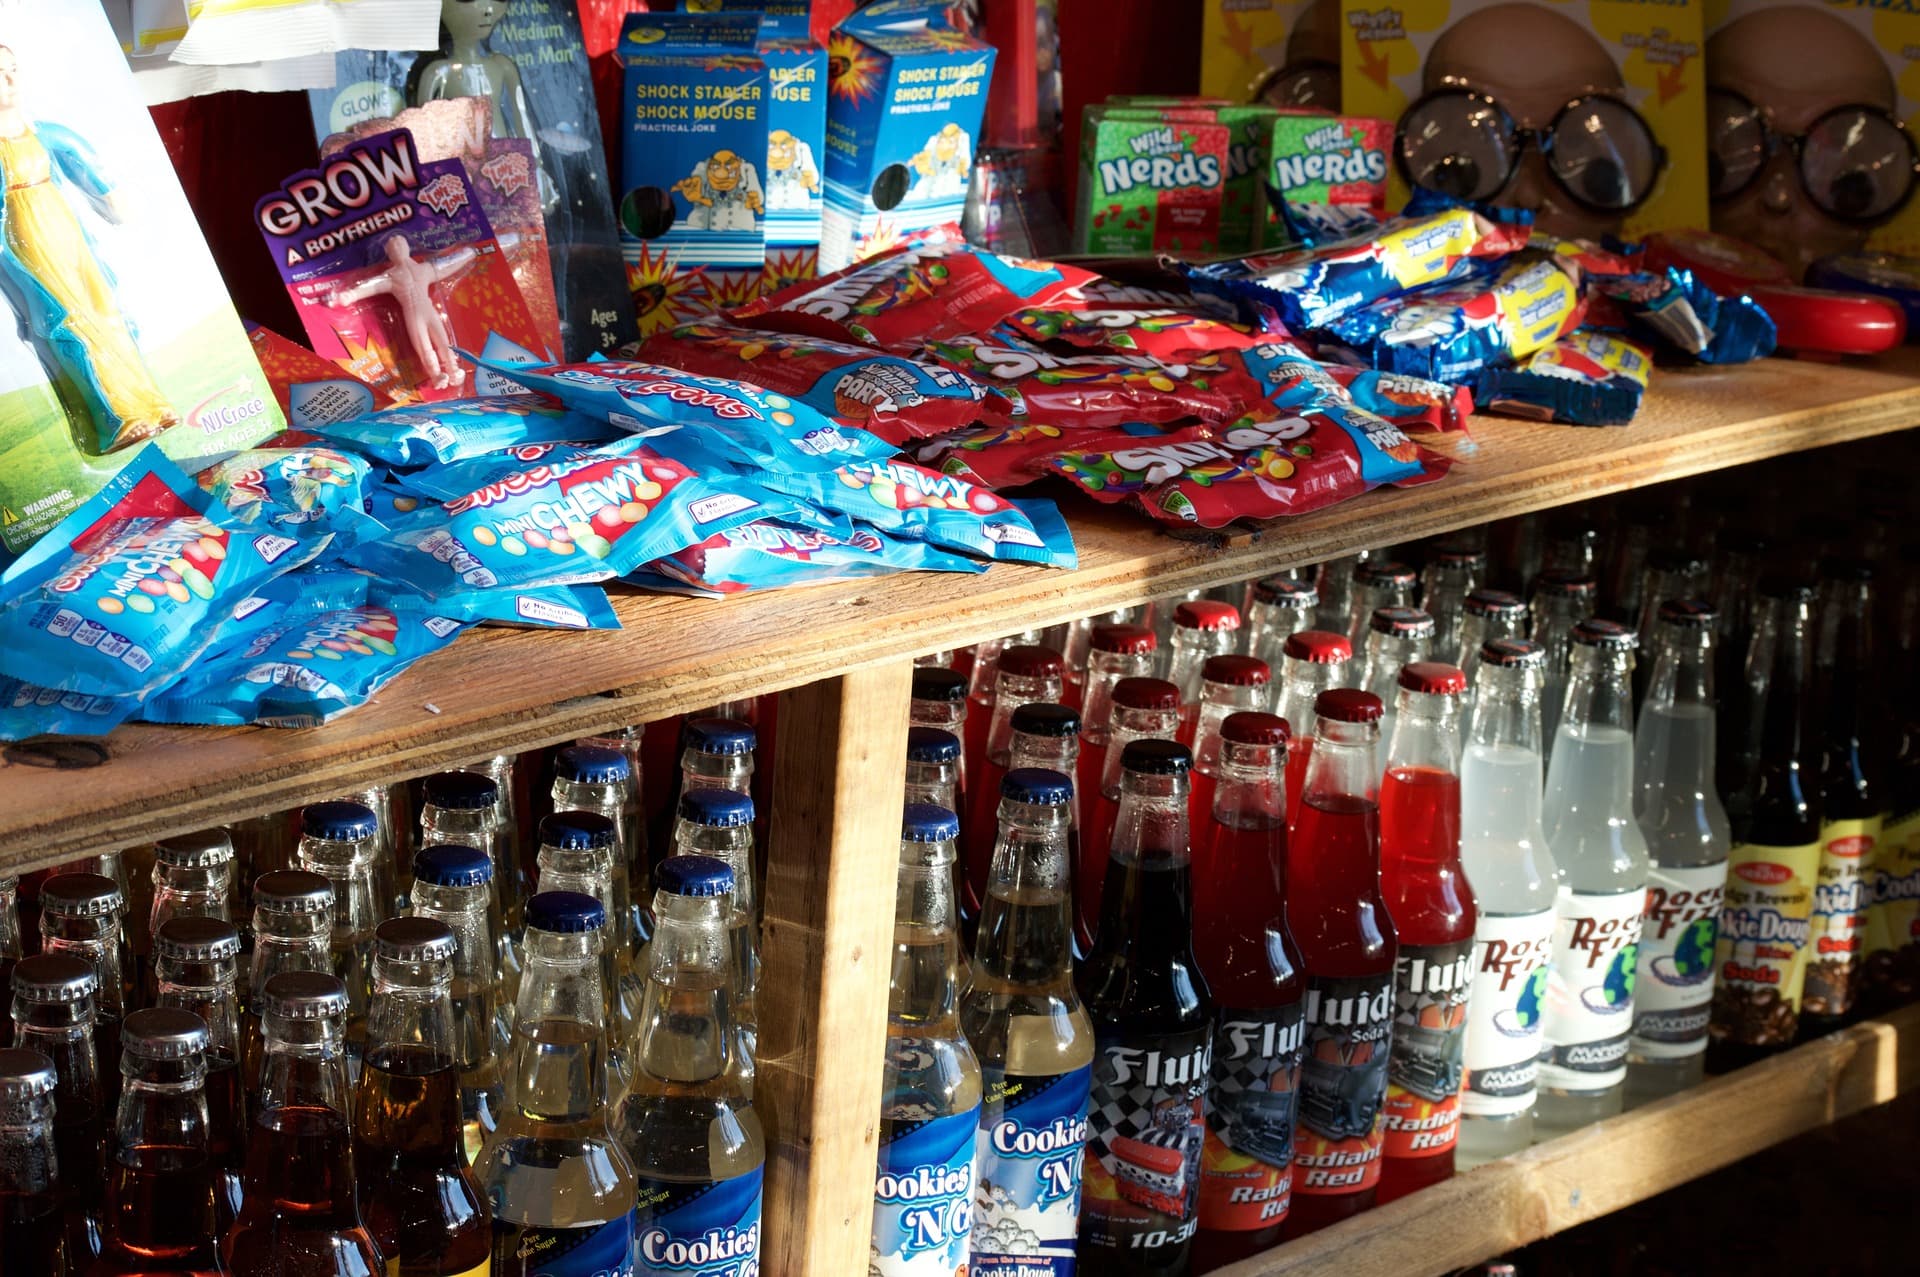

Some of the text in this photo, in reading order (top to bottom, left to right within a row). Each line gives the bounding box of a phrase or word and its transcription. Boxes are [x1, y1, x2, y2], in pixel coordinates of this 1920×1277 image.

[769, 68, 816, 83] APLER
[898, 63, 987, 84] SHOCK STAPLER
[637, 84, 761, 100] SHOCK STAPLER
[894, 81, 981, 103] SHOCK MOUSE
[636, 105, 757, 120] SHOCK MOUSE
[890, 101, 951, 115] PRACTICAL JOKE
[634, 124, 717, 133] PRACTICAL JOKE
[1303, 125, 1345, 151] Wild
[1129, 127, 1173, 154] Wild
[261, 135, 418, 236] GROW
[287, 247, 305, 268] A
[304, 203, 413, 258] BOYFRIEND
[591, 308, 618, 329] Ages
[601, 331, 617, 348] 3+
[507, 384, 525, 394] Gro
[832, 374, 899, 413] PARTY
[201, 399, 264, 434] NJCroce
[23, 489, 74, 516] WARNING:
[492, 461, 650, 537] MINI CHEWY
[108, 576, 147, 598] MINI
[533, 602, 546, 610] No
[53, 614, 68, 628] 50
[1723, 961, 1780, 984] Soda
[1351, 1029, 1384, 1044] Soda
[984, 1082, 1024, 1105] Cane Sugar
[991, 1080, 1008, 1091] Pure
[1410, 1127, 1458, 1151] Red
[1295, 1143, 1382, 1168] adiant
[876, 1164, 969, 1200] ookies
[1304, 1167, 1365, 1188] Red
[638, 1187, 655, 1198] Pure
[649, 1190, 671, 1205] Sugar
[1260, 1198, 1290, 1220] Re
[523, 1233, 541, 1245] Pure
[1130, 1216, 1198, 1249] 10-30
[515, 1236, 558, 1260] Cane Sugar
[642, 1226, 757, 1265] Cookies
[1000, 1256, 1014, 1264] the
